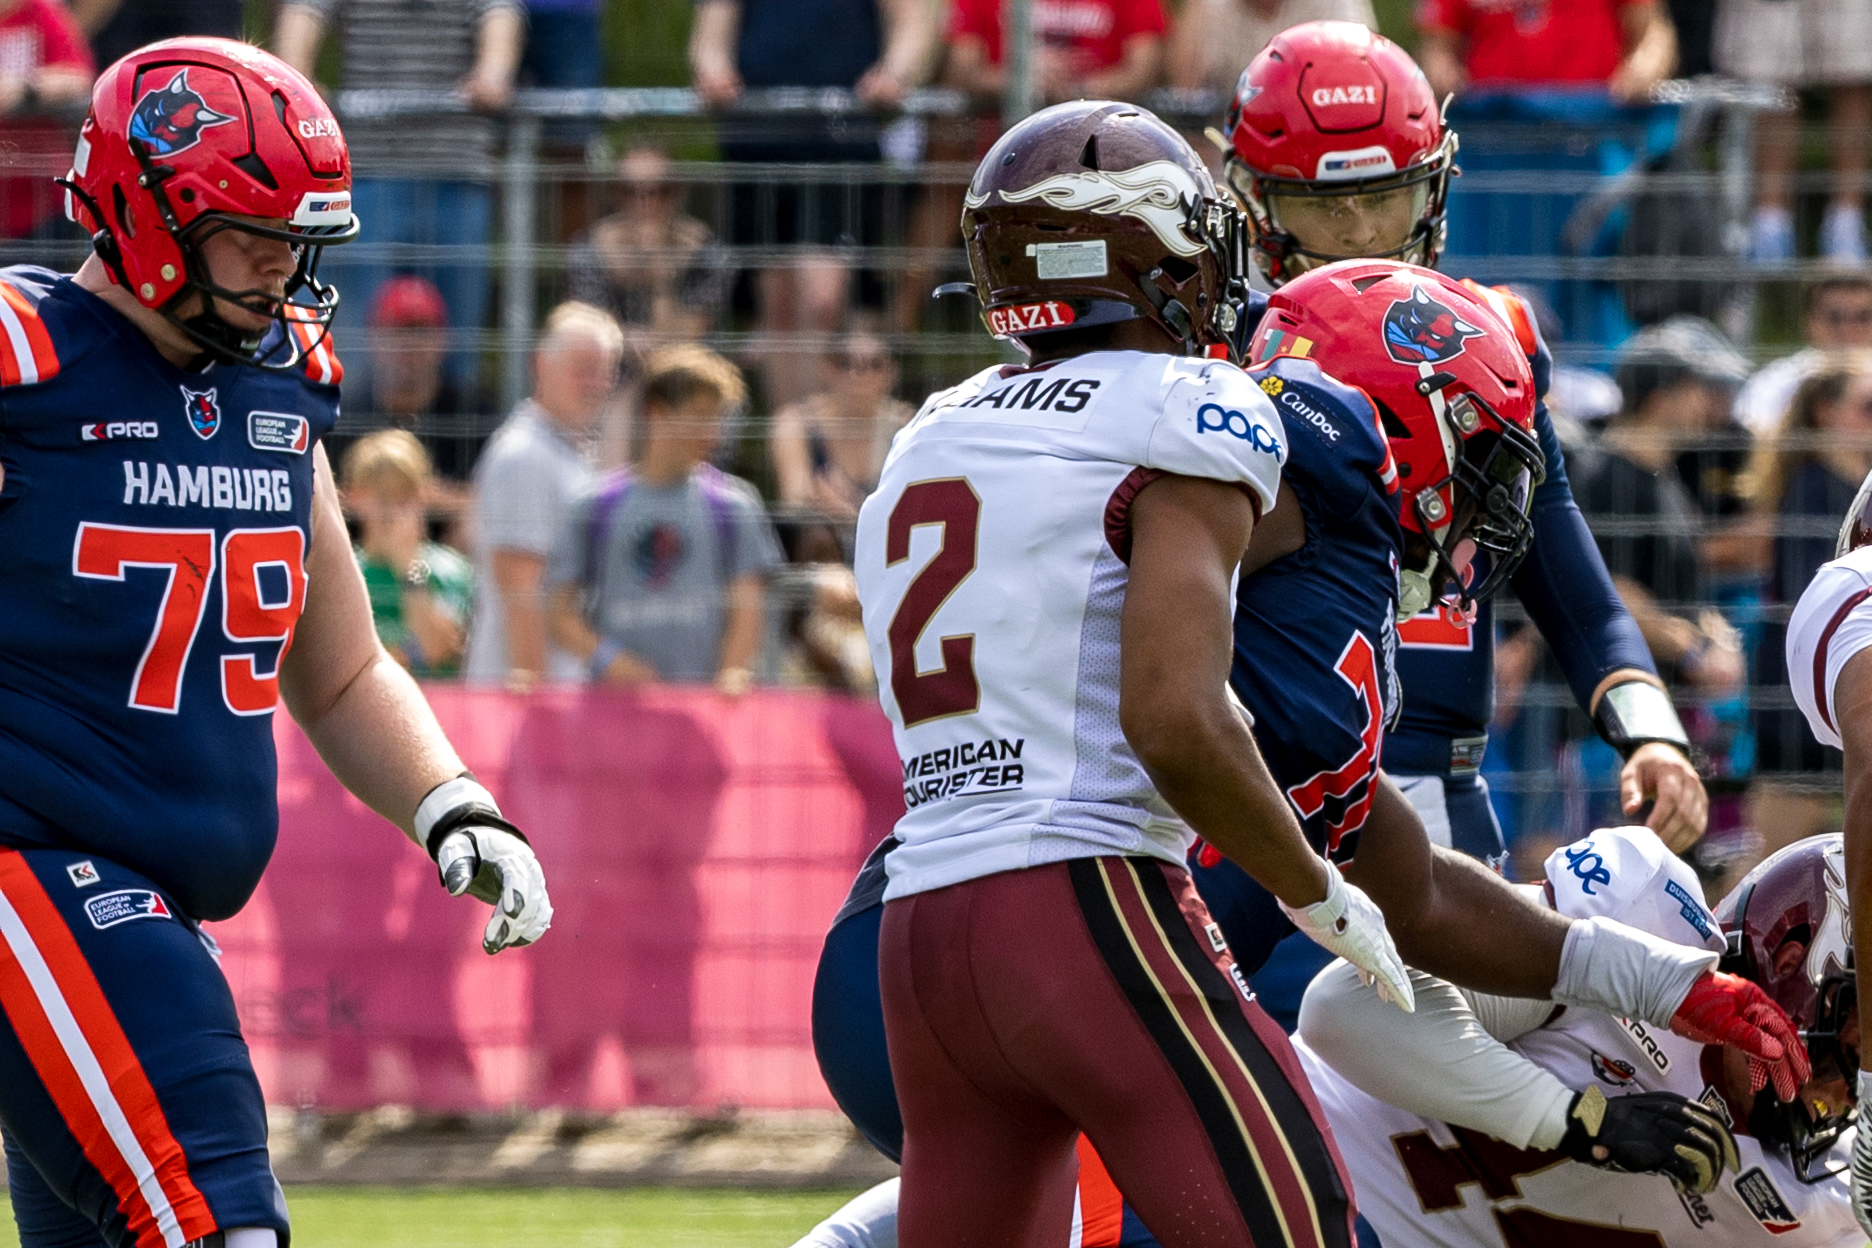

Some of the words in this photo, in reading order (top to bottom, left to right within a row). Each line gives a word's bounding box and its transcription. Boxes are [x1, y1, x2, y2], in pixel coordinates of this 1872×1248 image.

[298, 118, 341, 139] GAZ
[1281, 391, 1341, 442] CanDoc
[123, 461, 292, 511] HAMBURG
[72, 521, 309, 717] 79
[886, 475, 983, 730] 2
[900, 738, 1025, 782] MERICAN
[904, 763, 1025, 808] OURISTER
[90, 895, 132, 912] EUROPEAN
[94, 902, 123, 917] LEAGUE
[96, 906, 137, 924] FOOTBALL
